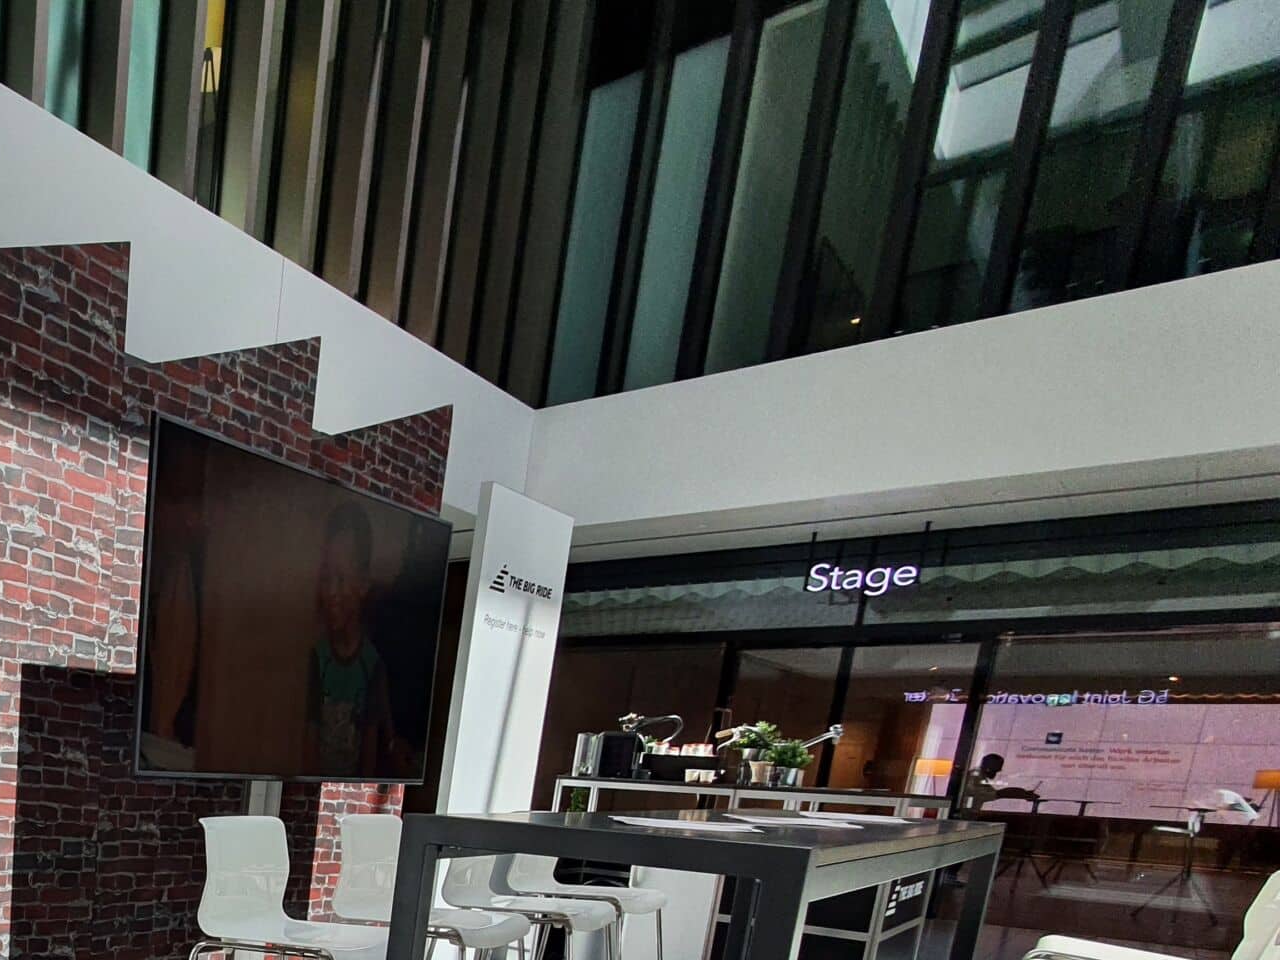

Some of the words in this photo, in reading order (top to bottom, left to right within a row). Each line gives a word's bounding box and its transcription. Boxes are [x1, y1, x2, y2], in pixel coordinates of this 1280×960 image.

[509, 575, 523, 590] THE
[523, 581, 536, 594] BIG
[536, 585, 552, 599] RIDE
[806, 563, 917, 596] Stage
